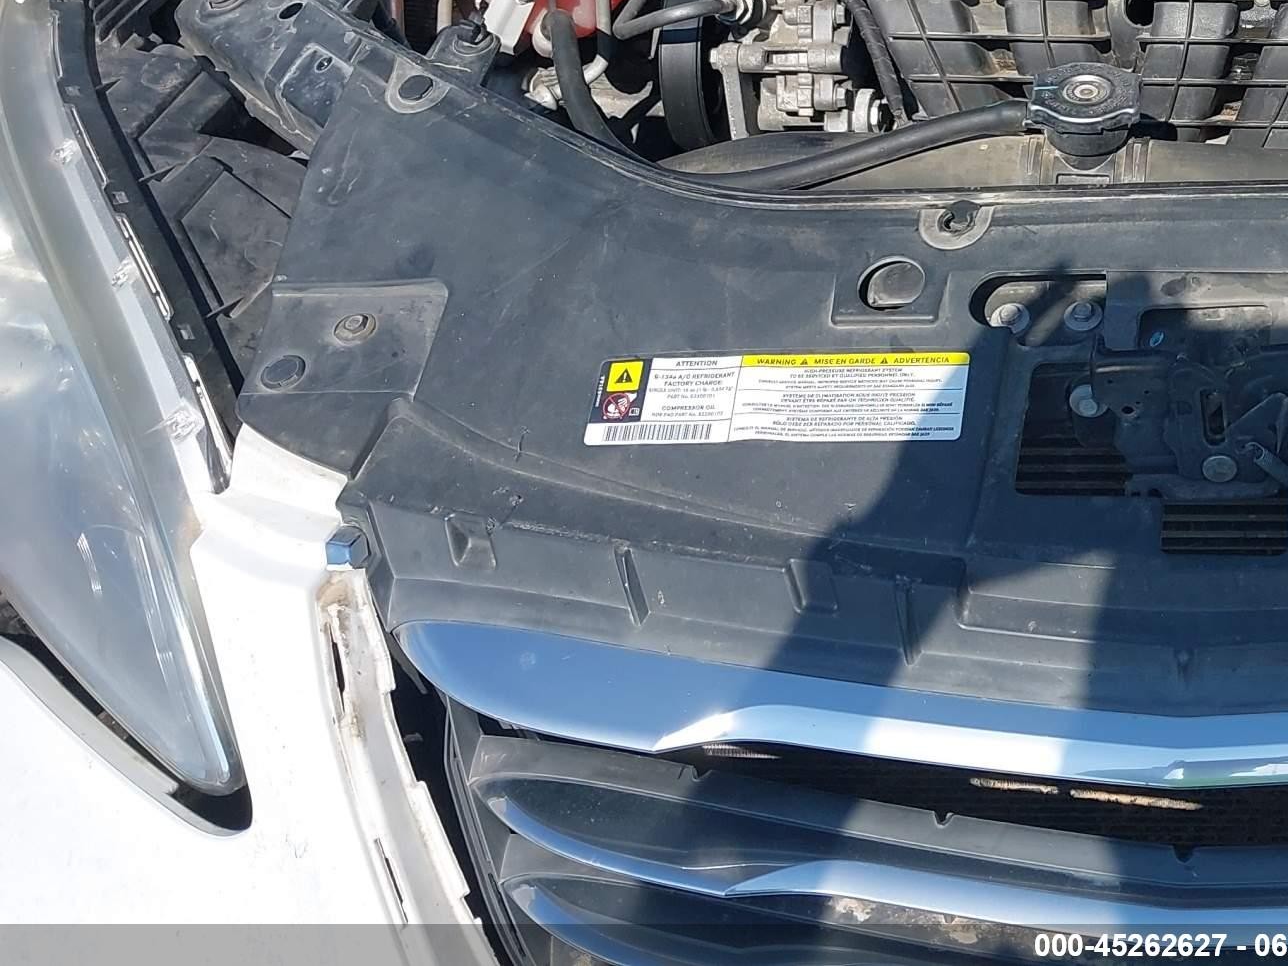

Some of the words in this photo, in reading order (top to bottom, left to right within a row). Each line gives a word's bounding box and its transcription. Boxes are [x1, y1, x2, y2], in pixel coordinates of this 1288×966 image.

[756, 358, 797, 366] WARNING
[848, 357, 876, 365] GARDE
[893, 356, 950, 364] ADVERTENCIA
